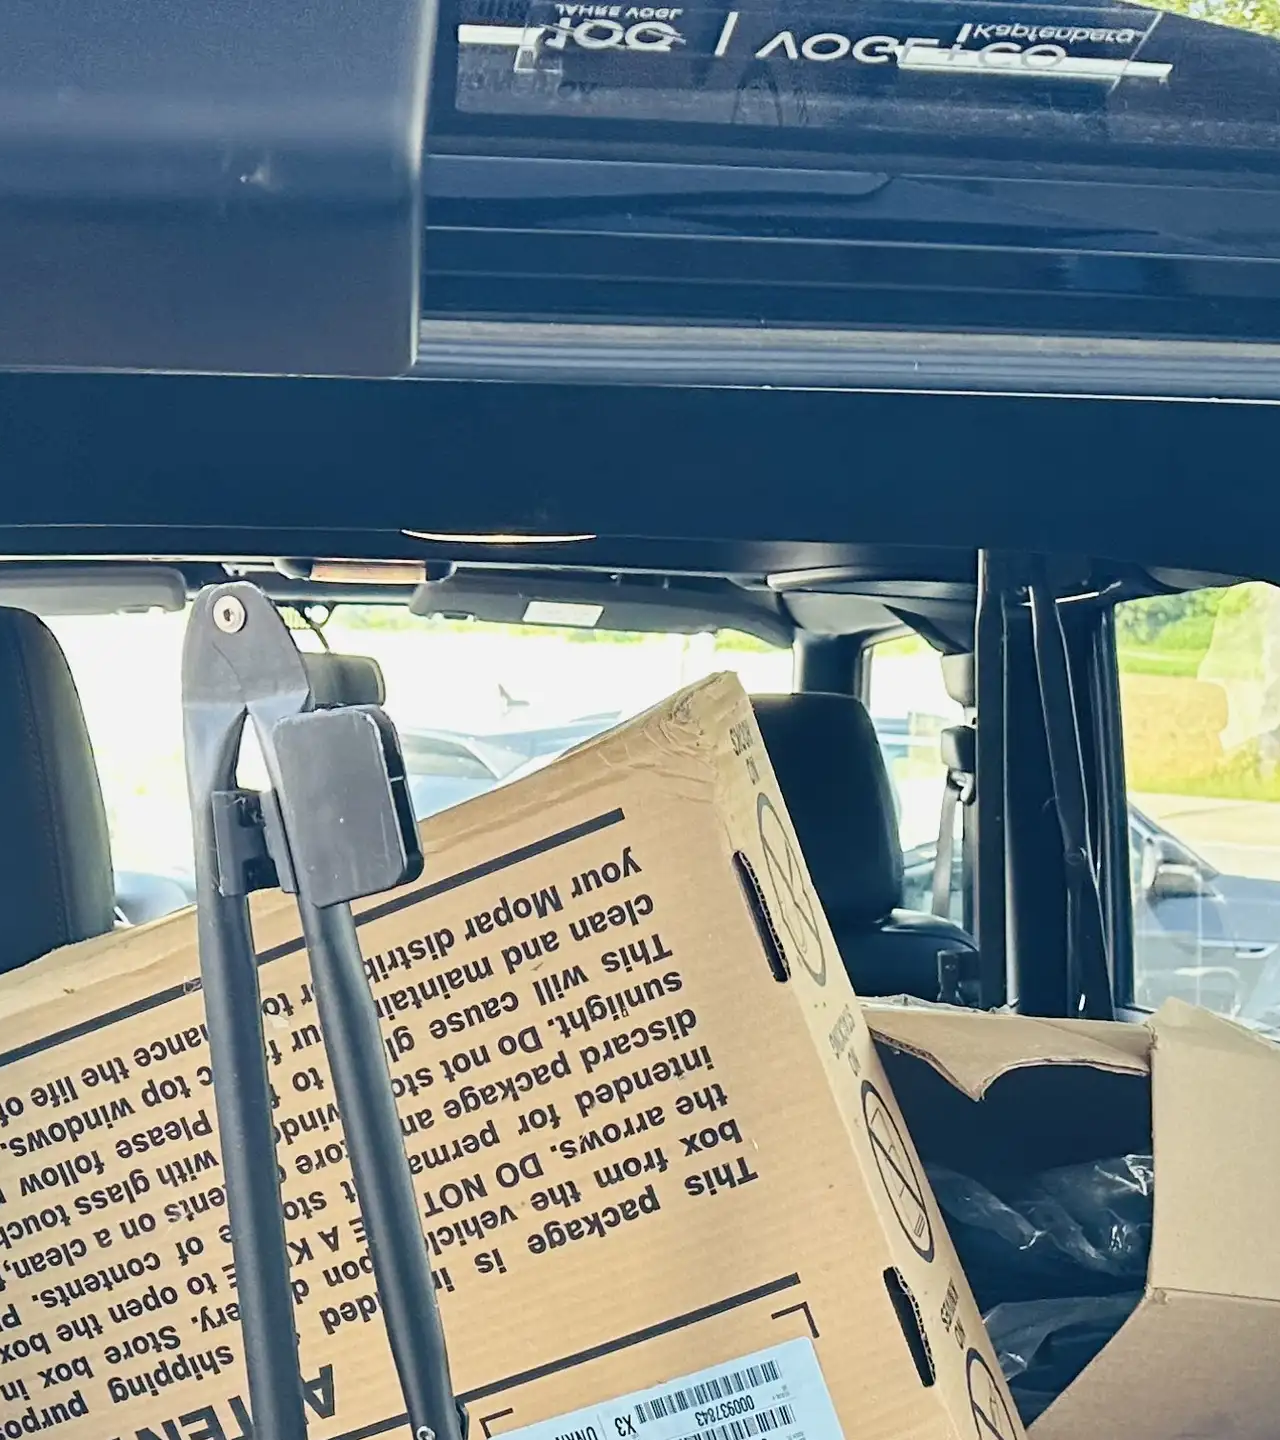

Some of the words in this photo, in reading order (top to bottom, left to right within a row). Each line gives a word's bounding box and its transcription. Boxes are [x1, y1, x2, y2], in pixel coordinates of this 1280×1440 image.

[569, 844, 643, 899] your
[462, 883, 565, 942] Mopar
[566, 892, 655, 942] clean
[499, 928, 561, 976] and
[599, 932, 674, 974] This
[260, 991, 295, 1018] to
[530, 963, 590, 1007] will
[545, 969, 683, 1040] sunlight.
[427, 989, 520, 1040] cause
[496, 1024, 545, 1057] Do
[577, 1007, 698, 1075] discard
[79, 1055, 131, 1088] the
[290, 1065, 325, 1093] to
[437, 1043, 492, 1084] not
[441, 1048, 573, 1120] package
[572, 1043, 715, 1119] intended
[28, 1074, 80, 1109] life
[139, 1073, 192, 1108] top
[673, 1081, 729, 1116] the
[113, 1107, 214, 1160] Please
[516, 1102, 562, 1137] for
[548, 1104, 666, 1160] arrows.
[677, 1116, 744, 1158] box
[17, 1148, 106, 1198] follow
[154, 1147, 221, 1188] with
[493, 1150, 545, 1189] DO
[591, 1145, 670, 1189] from
[682, 1154, 760, 1197] This
[72, 1166, 151, 1216] glass
[421, 1171, 489, 1219] NOT
[528, 1178, 583, 1212] the
[117, 1211, 157, 1240] on
[525, 1182, 662, 1255] package
[173, 1234, 205, 1267] of
[472, 1246, 508, 1275] is
[29, 1250, 162, 1309] contents.
[185, 1270, 219, 1296] to
[105, 1283, 179, 1325] open
[54, 1311, 104, 1343] the
[102, 1323, 182, 1365] Store
[35, 1354, 95, 1390] box
[105, 1344, 235, 1405] shipping
[614, 1413, 636, 1437] X3
[694, 1394, 755, 1427] 000937843
